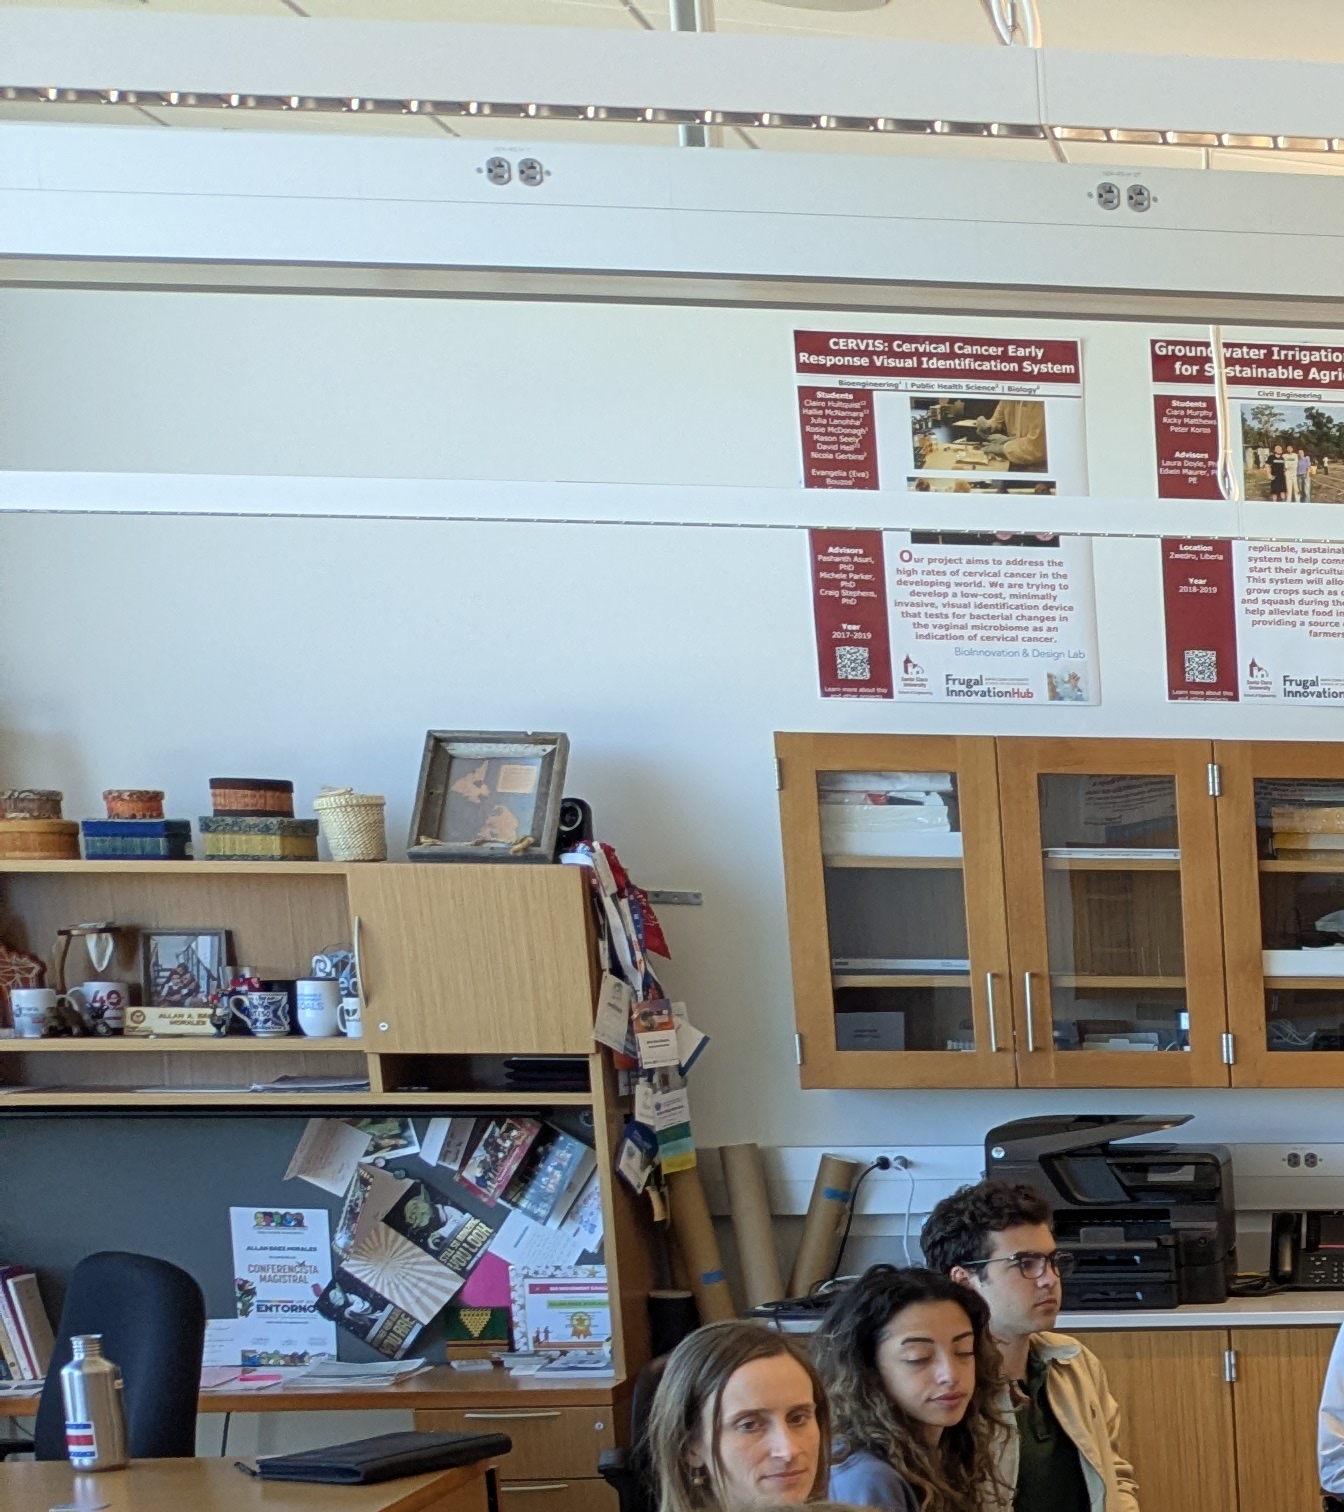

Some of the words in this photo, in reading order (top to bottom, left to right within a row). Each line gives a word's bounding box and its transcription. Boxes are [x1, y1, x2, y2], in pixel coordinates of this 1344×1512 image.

[829, 338, 888, 351] CERVIS:
[893, 340, 950, 353] Cervical
[954, 343, 1004, 355] Cancer
[1008, 346, 1044, 359] Early
[799, 353, 869, 366] Response
[874, 356, 917, 368] Visual
[922, 358, 1018, 372] Identification
[1023, 362, 1075, 374] System
[1174, 362, 1199, 376] for
[1204, 363, 1303, 380] Sstainable
[910, 382, 936, 390] Public
[1277, 391, 1322, 400] Engineering
[1171, 400, 1206, 408] Students
[1179, 544, 1212, 552] Location
[1248, 545, 1298, 554] replicable,
[897, 579, 950, 589] developing
[1026, 582, 1056, 590] trying
[1178, 586, 1217, 594] 2018-2019
[910, 589, 948, 599] develop
[961, 591, 1006, 600] low-cost,
[1009, 592, 1057, 601] minimally
[894, 600, 938, 609] invasive,
[942, 601, 970, 609] visual
[974, 602, 1039, 611] identification
[1245, 608, 1265, 616] help
[1268, 608, 1308, 616] alleviate
[916, 632, 964, 640] indication
[981, 634, 1018, 642] cervical
[1021, 635, 1057, 643] cancer.
[1022, 649, 1029, 657] &
[1032, 649, 1064, 660] Design
[1068, 650, 1085, 658] Lab
[945, 674, 983, 688] Frugal
[1283, 675, 1318, 688] Frugal
[946, 686, 1033, 699] InnovationHub
[248, 1264, 318, 1274] CONFERENCISTA
[260, 1274, 308, 1284] MAGISTRAL
[257, 1304, 316, 1313] ENTORNO
